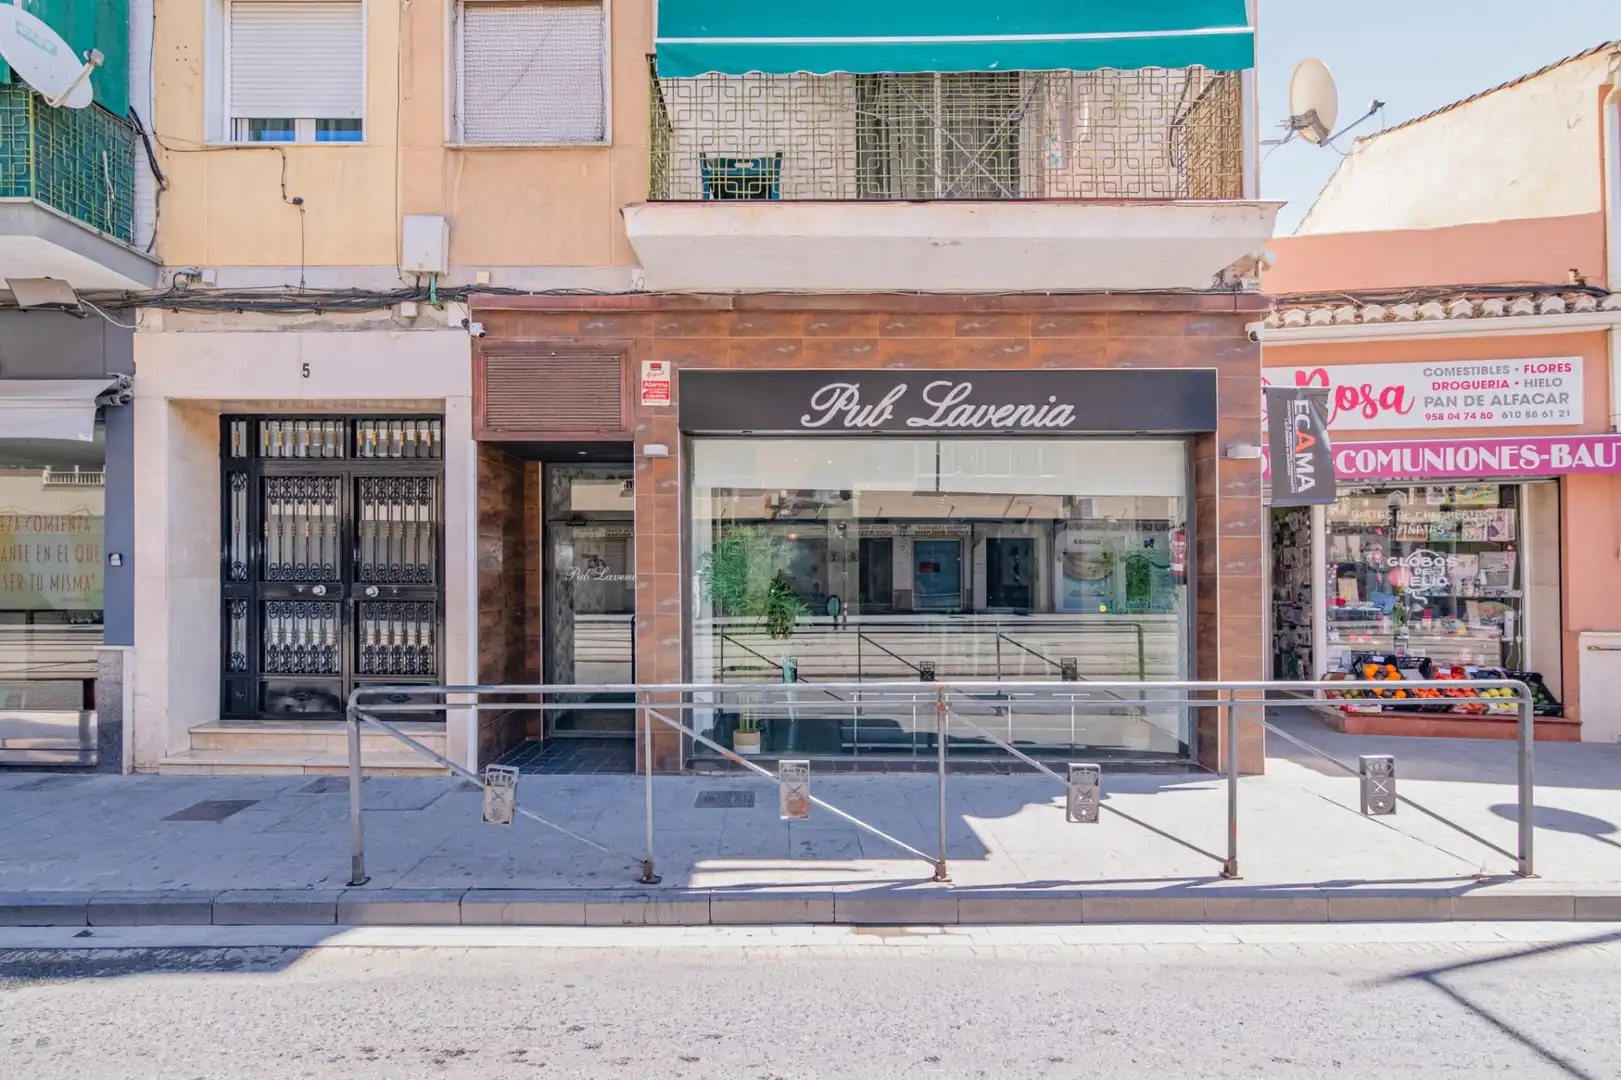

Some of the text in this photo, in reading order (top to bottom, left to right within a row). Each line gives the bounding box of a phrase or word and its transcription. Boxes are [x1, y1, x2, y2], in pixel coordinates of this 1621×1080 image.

[303, 363, 310, 378] 5
[1423, 363, 1572, 377] COMESTIBLES FLORES
[1431, 378, 1563, 391] DROGUERIA HIELO
[800, 380, 1076, 428] Pub Lavenia
[1424, 392, 1570, 408] PAN DE ALFACAR
[1425, 413, 1444, 421] 958
[1447, 412, 1461, 421] 04
[1464, 412, 1477, 420] 74
[1501, 411, 1522, 419] 610
[1542, 410, 1554, 418] 61
[1558, 409, 1571, 418] 21
[1294, 400, 1316, 493] ECAMA
[1336, 442, 1621, 473] COMUNIONES-BAU
[36, 544, 51, 563] EN
[57, 544, 69, 563] EL
[75, 544, 101, 563] QUE
[1387, 556, 1458, 567] GLOBOS
[3, 573, 24, 592] SER
